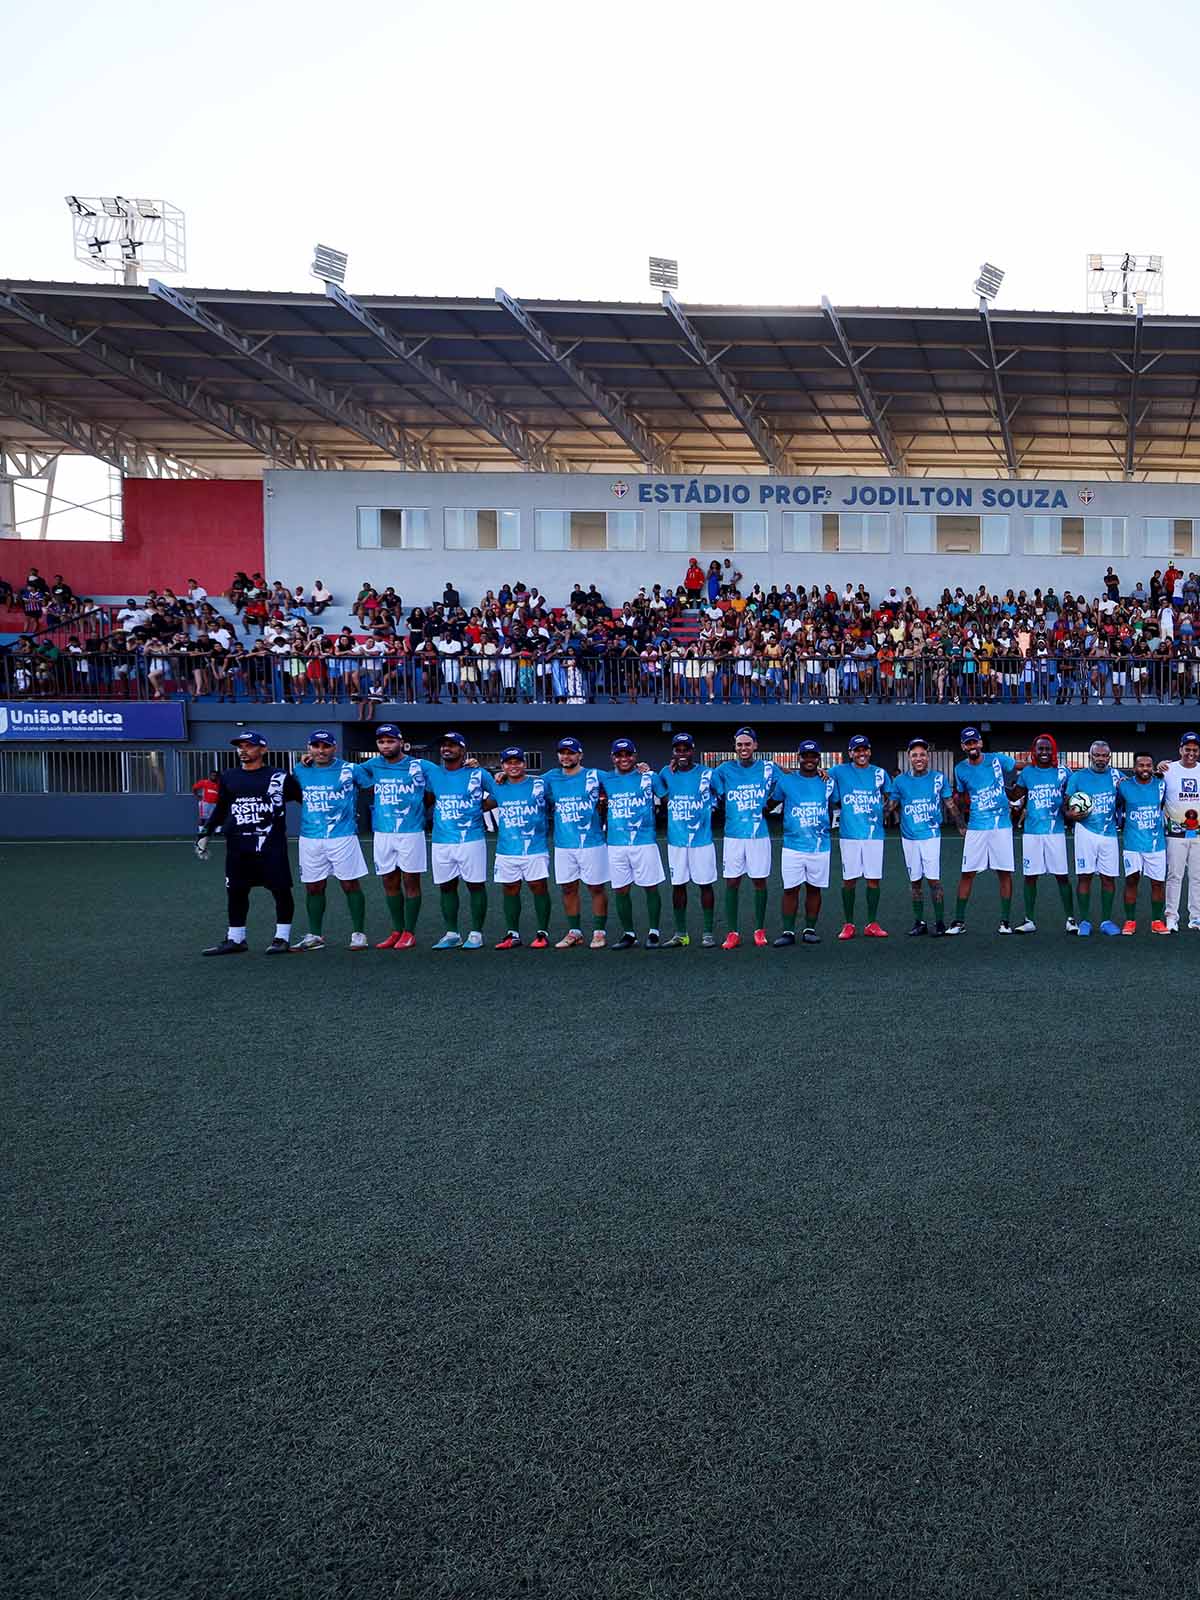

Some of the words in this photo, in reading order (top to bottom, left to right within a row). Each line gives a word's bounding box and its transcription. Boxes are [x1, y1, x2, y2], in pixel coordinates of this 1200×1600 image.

[638, 478, 750, 504] ESTÁDIO
[842, 486, 972, 507] JODILTON
[982, 488, 1068, 509] SOUZA
[10, 709, 60, 724] União
[62, 709, 123, 724] Médica
[306, 801, 335, 812] BELL
[736, 800, 760, 812] BELL
[1034, 800, 1054, 809] BELL
[440, 810, 464, 820] BELL
[560, 812, 584, 824] BELL
[612, 808, 636, 818] BELL
[672, 810, 694, 820] BELL
[912, 813, 934, 824] BELL
[234, 814, 264, 825] BELL
[504, 816, 528, 828] BELL
[800, 816, 822, 828] BELL
